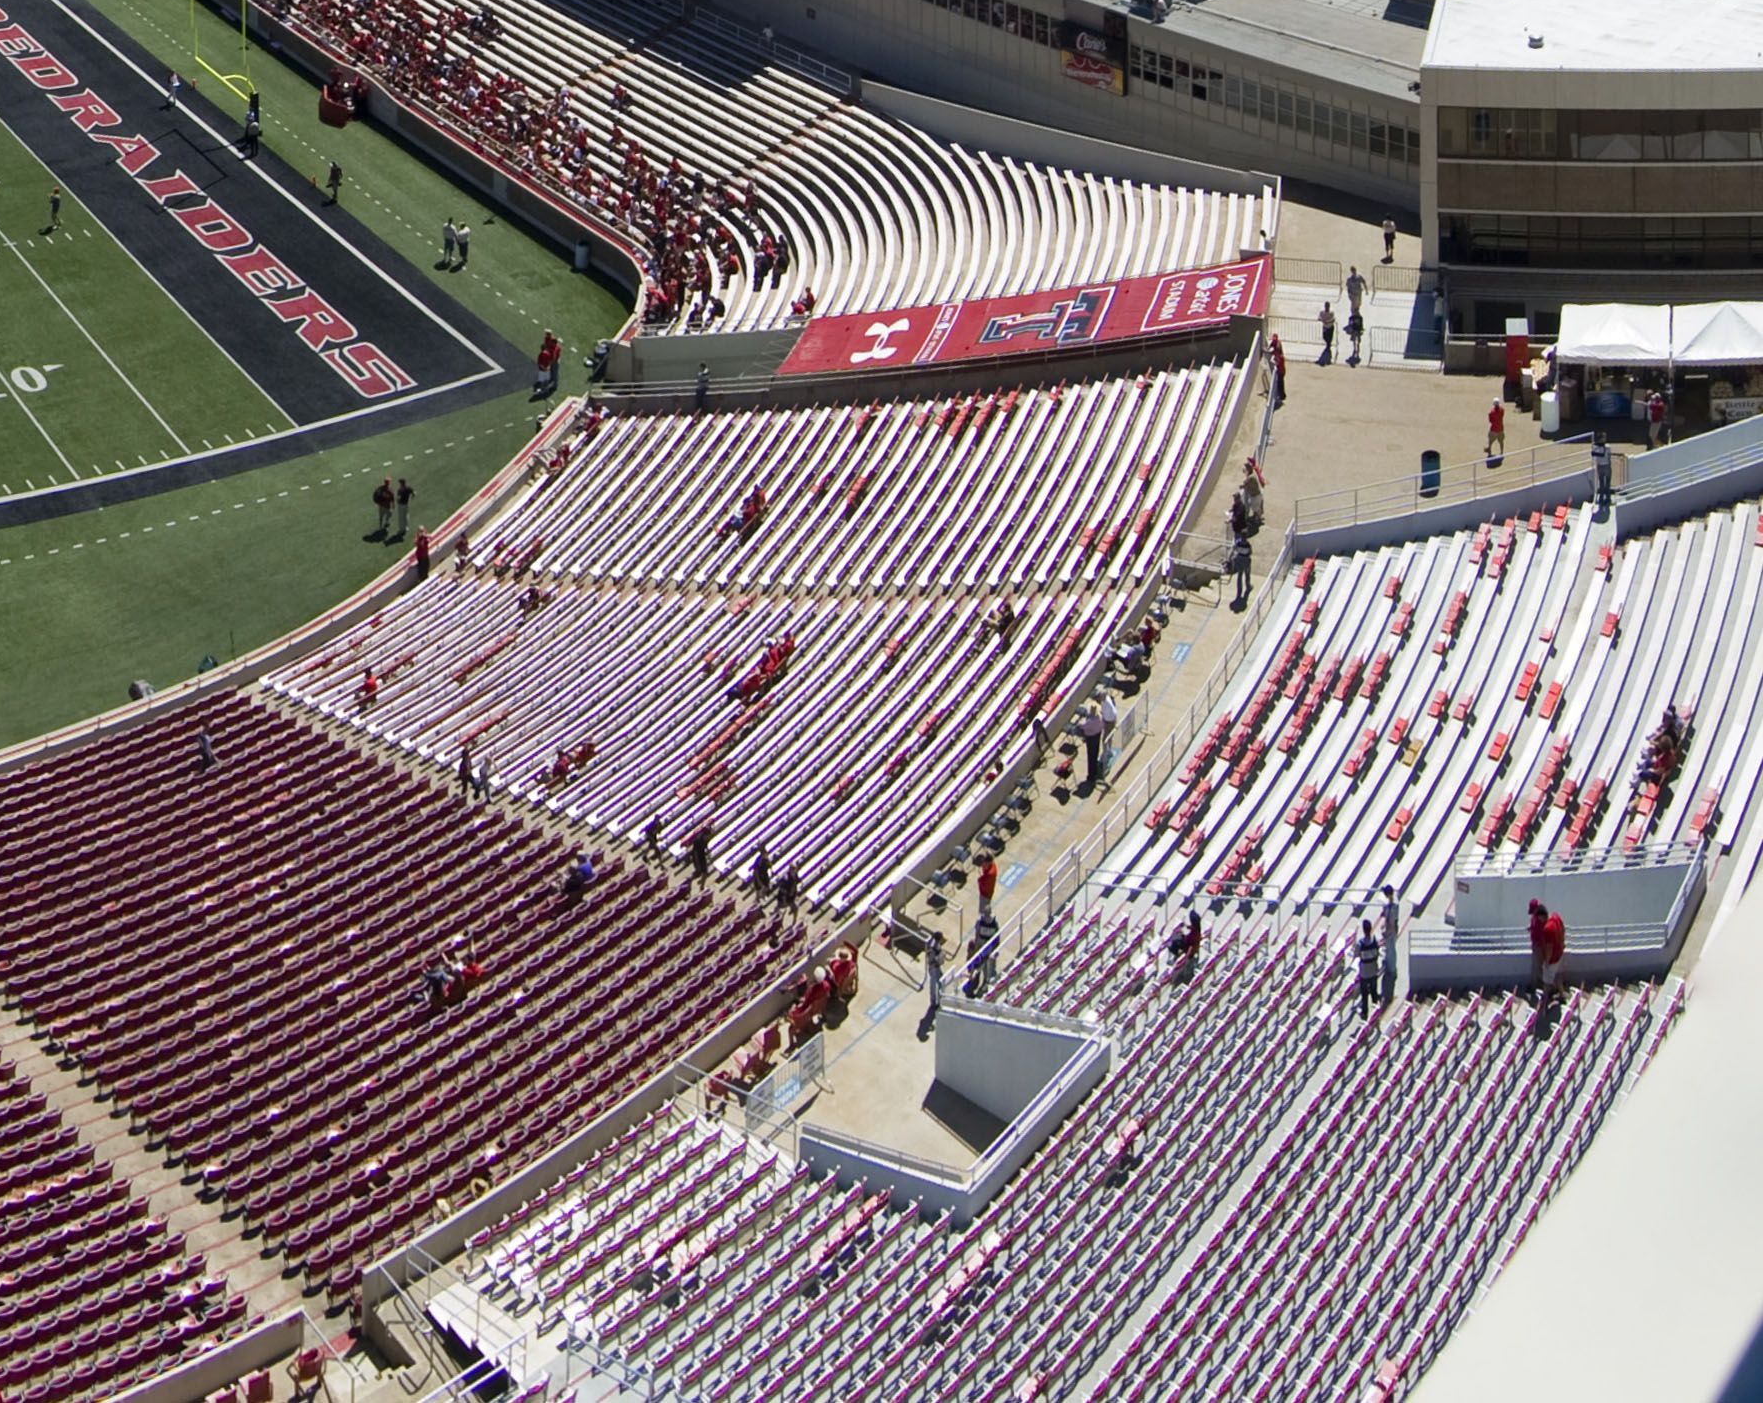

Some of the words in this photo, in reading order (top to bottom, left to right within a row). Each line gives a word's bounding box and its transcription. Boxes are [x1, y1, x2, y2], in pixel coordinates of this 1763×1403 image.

[45, 86, 419, 399] RAIDERS
[1157, 280, 1186, 321] STADIUM
[1215, 273, 1248, 314] JONES
